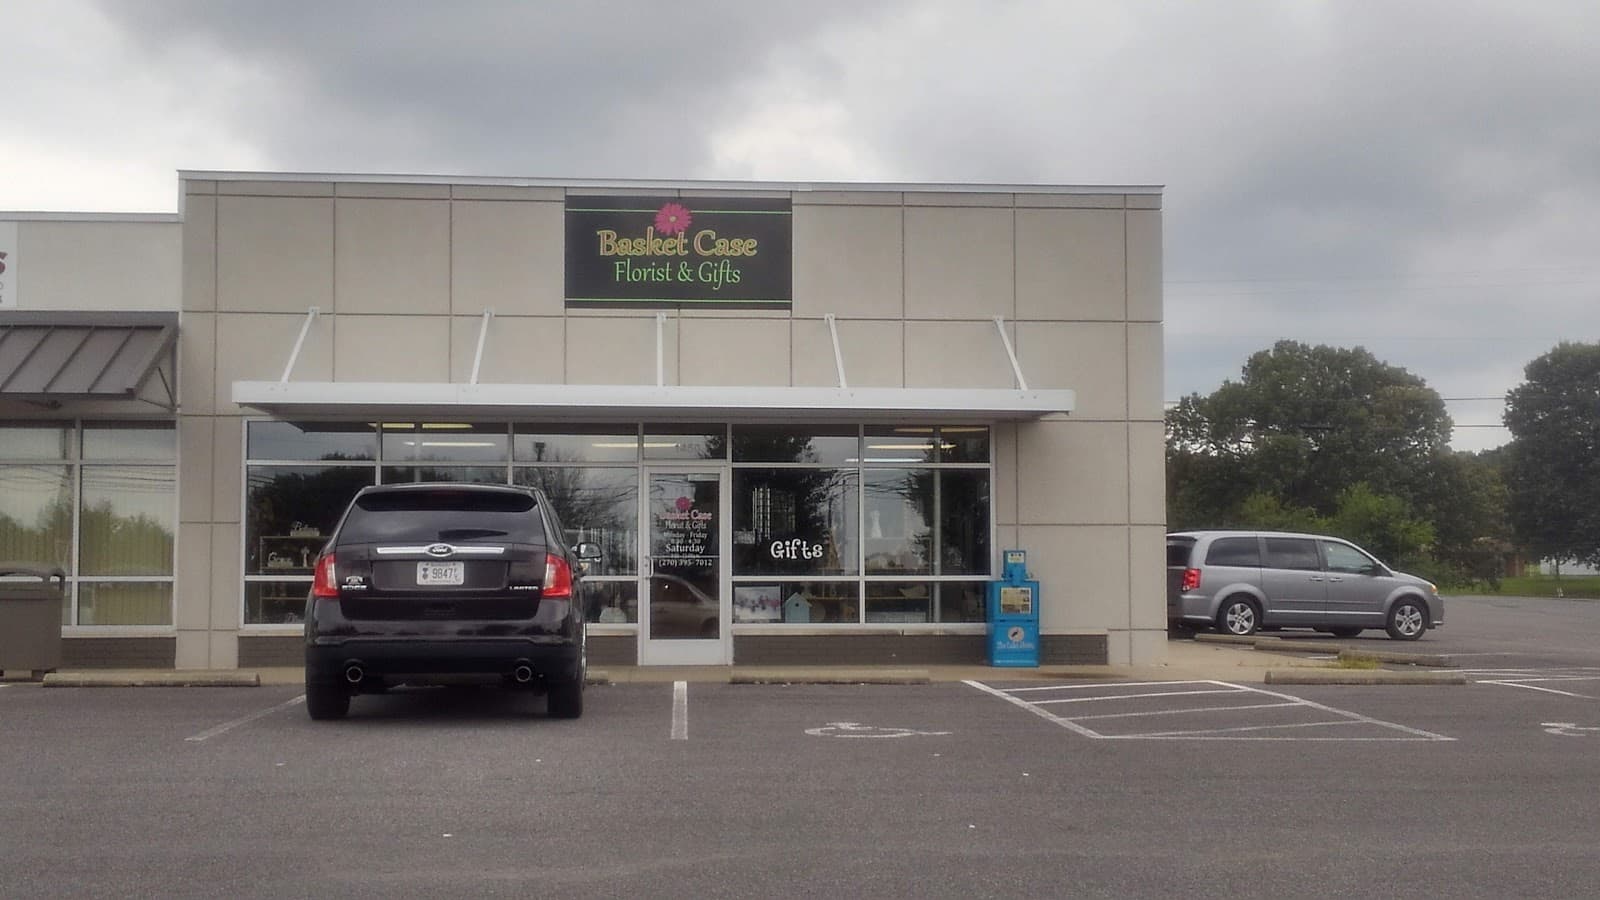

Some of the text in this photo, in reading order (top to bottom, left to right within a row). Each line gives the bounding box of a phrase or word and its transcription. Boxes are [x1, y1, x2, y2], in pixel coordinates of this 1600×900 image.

[596, 226, 758, 257] Basket Case
[614, 258, 741, 290] Florist & Gifts
[690, 509, 713, 520] Case
[690, 531, 708, 539] Friday
[665, 543, 706, 554] Saturday
[770, 539, 824, 560] Gifts
[658, 559, 678, 567] (270)
